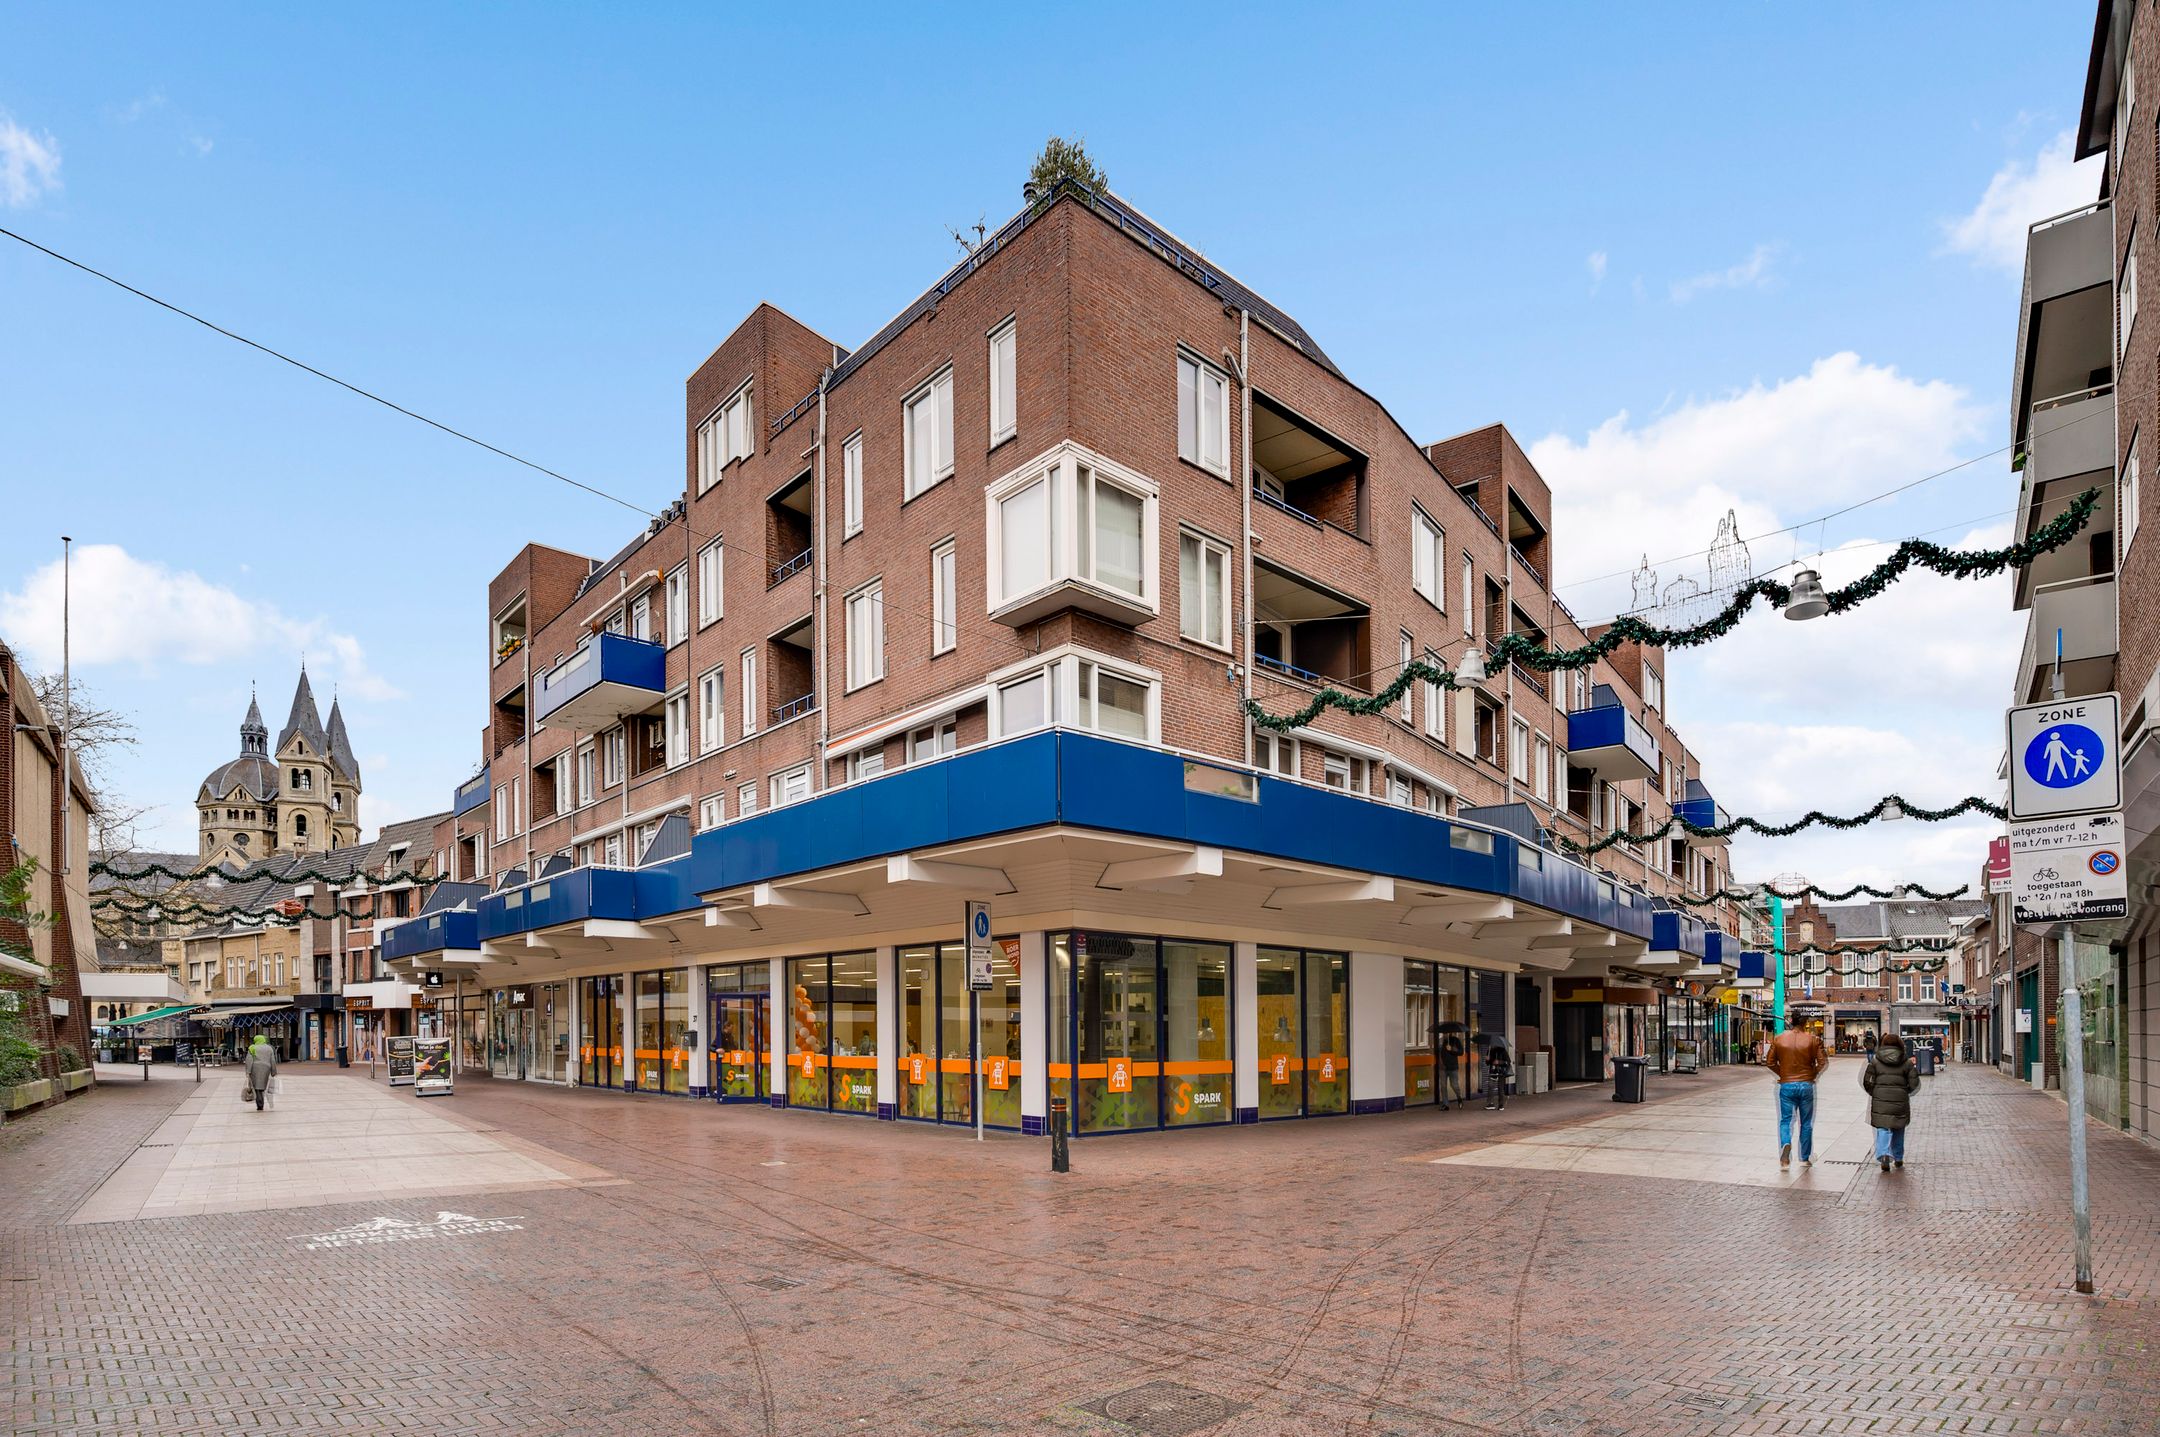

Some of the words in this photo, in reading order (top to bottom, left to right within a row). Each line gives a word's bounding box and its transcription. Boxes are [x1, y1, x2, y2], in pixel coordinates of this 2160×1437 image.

[2038, 706, 2086, 723] ZONE
[2012, 822, 2076, 837] uitgezonderd
[2013, 840, 2027, 849] ma
[2030, 837, 2051, 847] t/m
[2066, 833, 2089, 842] 7-12
[2091, 832, 2098, 840] h
[2027, 880, 2082, 892] toegestaan
[2060, 890, 2073, 899] na
[2075, 889, 2094, 898] 18h
[646, 1070, 658, 1078] SPARK
[852, 1084, 872, 1095] SPARK
[1194, 1092, 1221, 1104] SPARK
[307, 1232, 436, 1250] FIETSERS
[443, 1224, 524, 1235] LOPEN
[312, 1226, 433, 1241] WINKELS
[440, 1220, 506, 1230] OPEN
